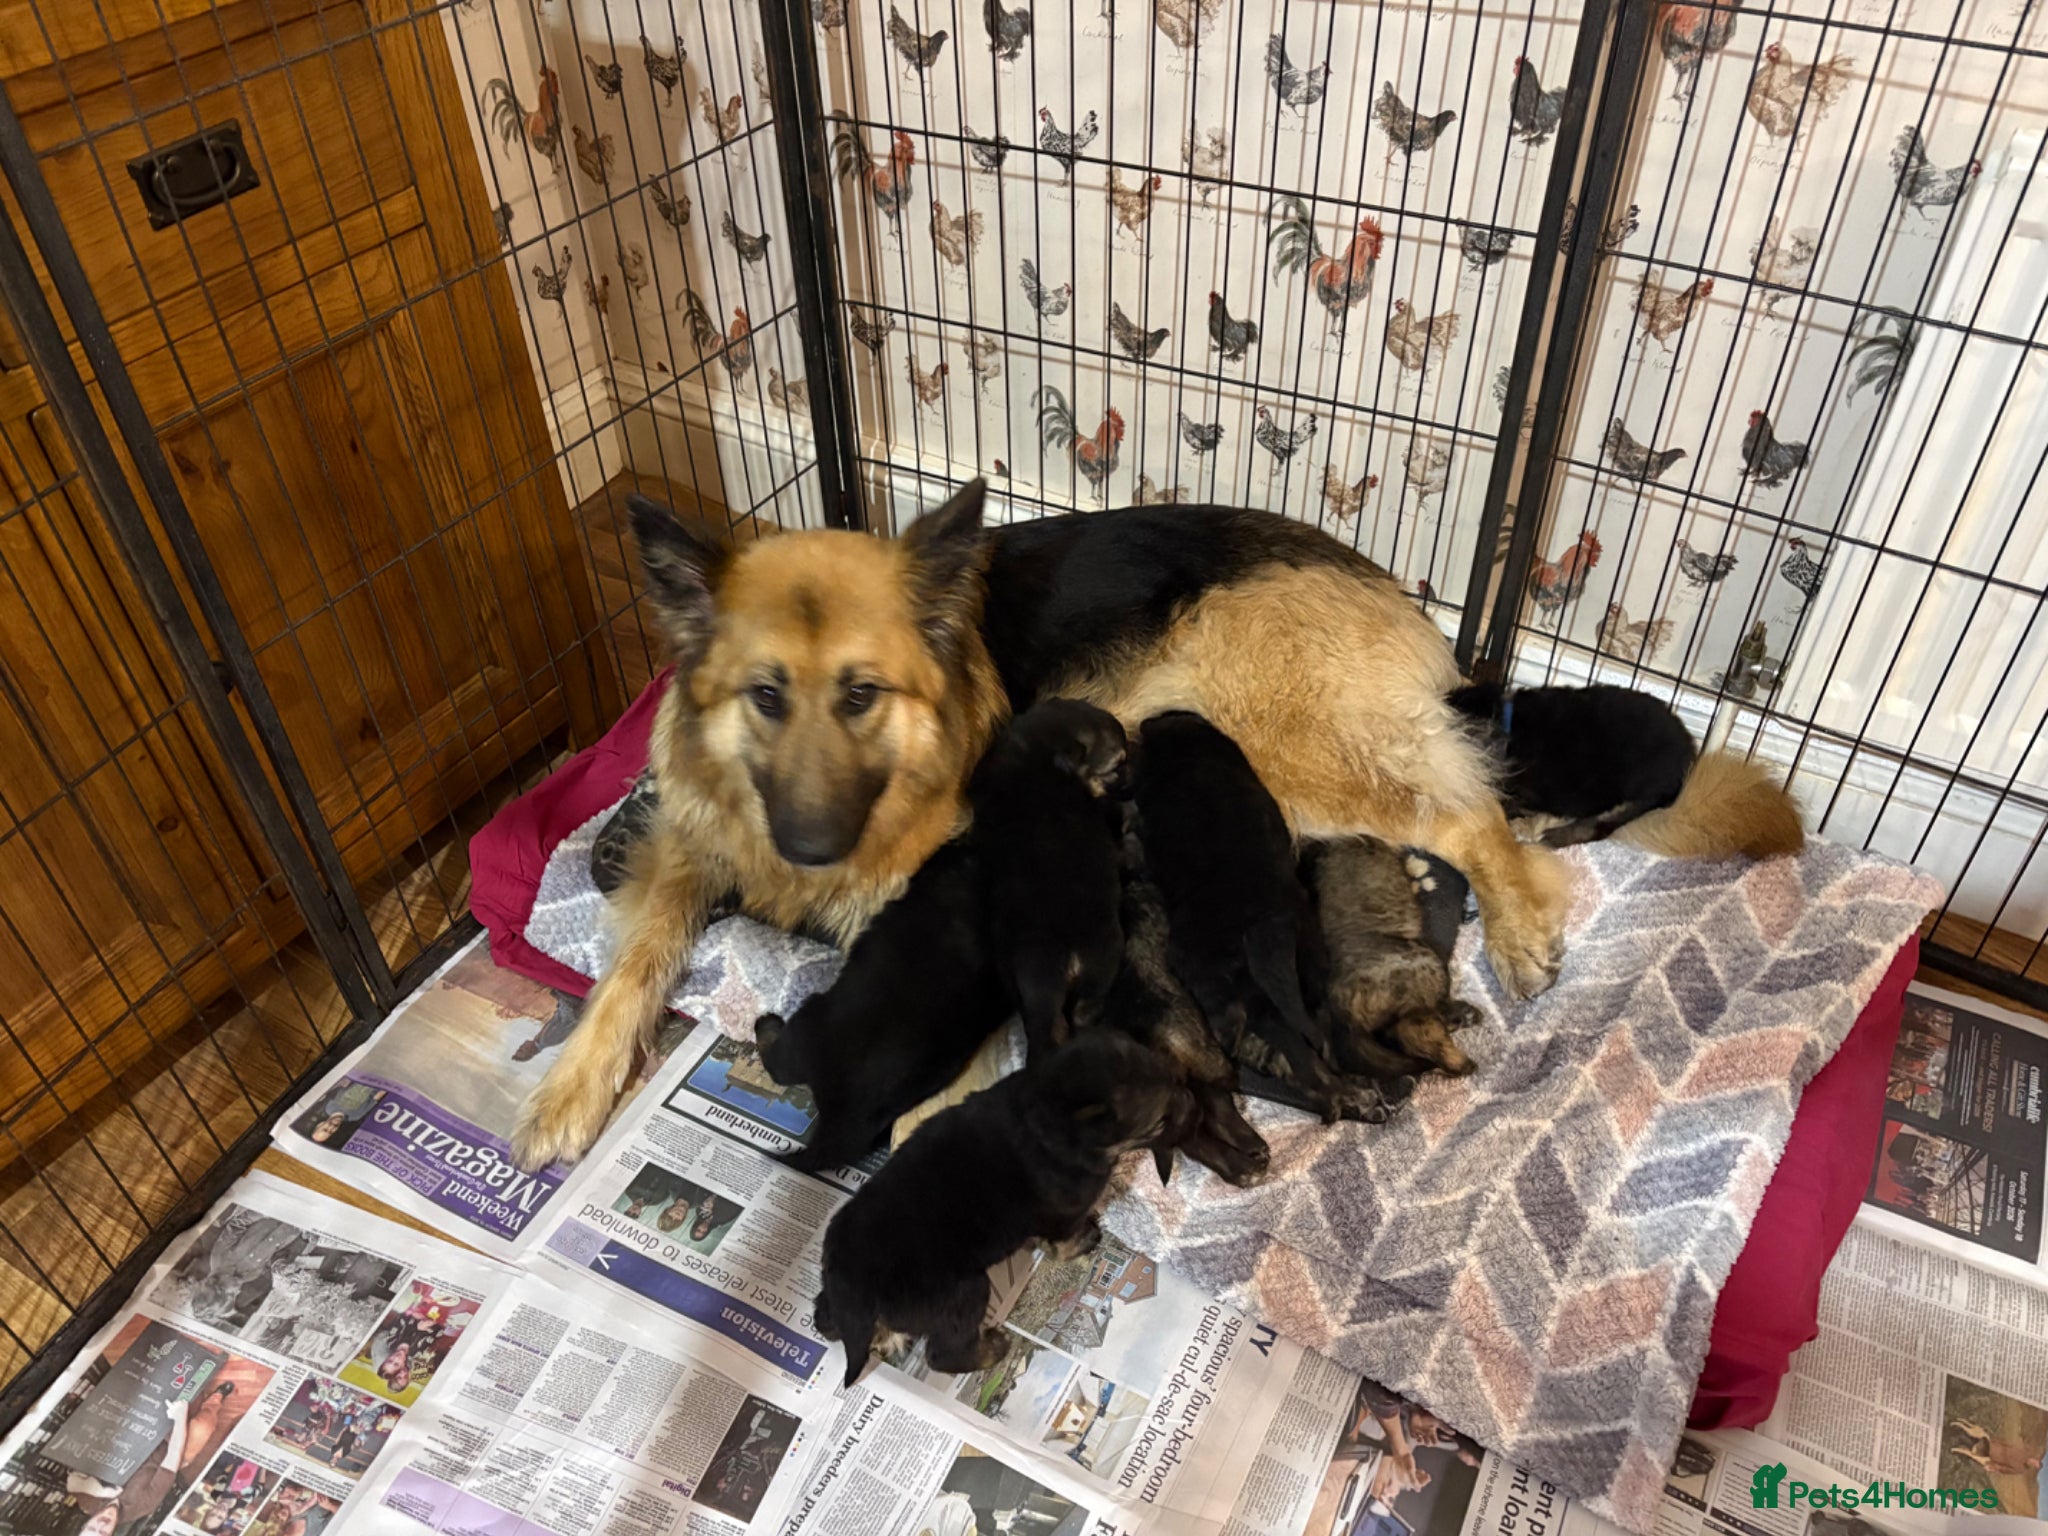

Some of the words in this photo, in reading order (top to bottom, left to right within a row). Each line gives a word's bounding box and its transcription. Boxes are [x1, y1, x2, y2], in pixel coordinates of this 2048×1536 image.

[705, 1105, 792, 1151] Cumberland
[345, 1142, 374, 1163] BOOKS
[372, 1151, 393, 1169] THE
[374, 1101, 552, 1213] Magazine
[391, 1163, 408, 1179] OF
[411, 1174, 434, 1195] PICK
[442, 1180, 525, 1232] Weekend
[578, 1203, 660, 1251] download
[662, 1245, 681, 1261] to
[682, 1257, 748, 1291] releases
[750, 1285, 798, 1323] latest
[721, 1307, 811, 1367] Television
[1194, 1305, 1221, 1346] quiet
[1152, 1345, 1201, 1426] cul-de-sac
[851, 1393, 885, 1435] Dairy
[813, 1435, 860, 1497] breeders
[1117, 1426, 1167, 1489] location
[1140, 1389, 1212, 1504] four-bedroom
[662, 1479, 691, 1498] Digital
